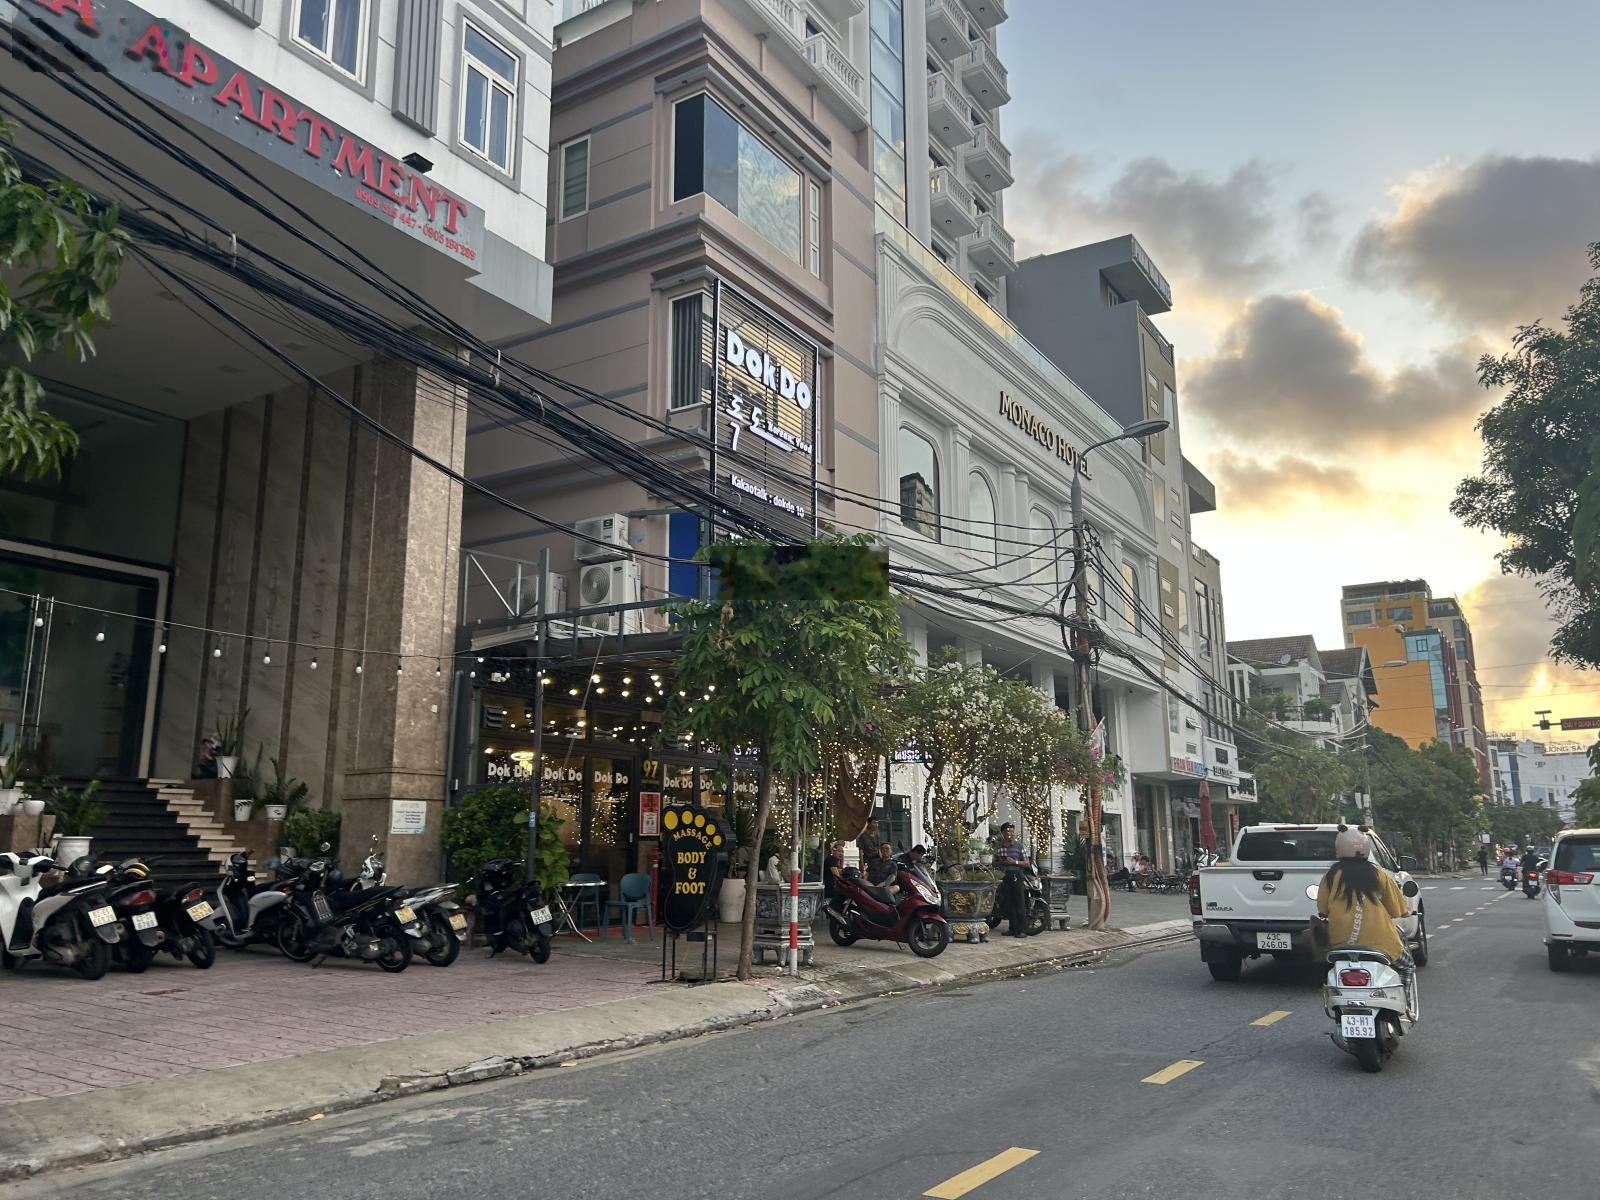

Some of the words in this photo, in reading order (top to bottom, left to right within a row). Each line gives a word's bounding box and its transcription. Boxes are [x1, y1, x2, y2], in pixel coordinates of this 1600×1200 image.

[124, 24, 469, 235] APARTMENT
[999, 390, 1056, 451] MONACO
[1055, 434, 1093, 481] HOTEL
[731, 473, 768, 501] Kakaotalk
[487, 762, 511, 778] Dok
[544, 767, 565, 781] Dok
[568, 769, 583, 782] Do
[643, 760, 659, 779] 97
[594, 771, 613, 784] Dok
[615, 772, 629, 785] Do
[681, 778, 694, 789] Do
[733, 781, 748, 793] Dok
[749, 783, 759, 793] Do
[672, 828, 713, 850] MASSAGE
[677, 851, 707, 864] BODY
[687, 867, 697, 880] &
[674, 881, 706, 895] FOOT
[1266, 933, 1282, 941] 43C
[1261, 941, 1288, 949] 246.05
[1346, 1016, 1370, 1026] 43-H1
[1344, 1026, 1375, 1037] 185.92
